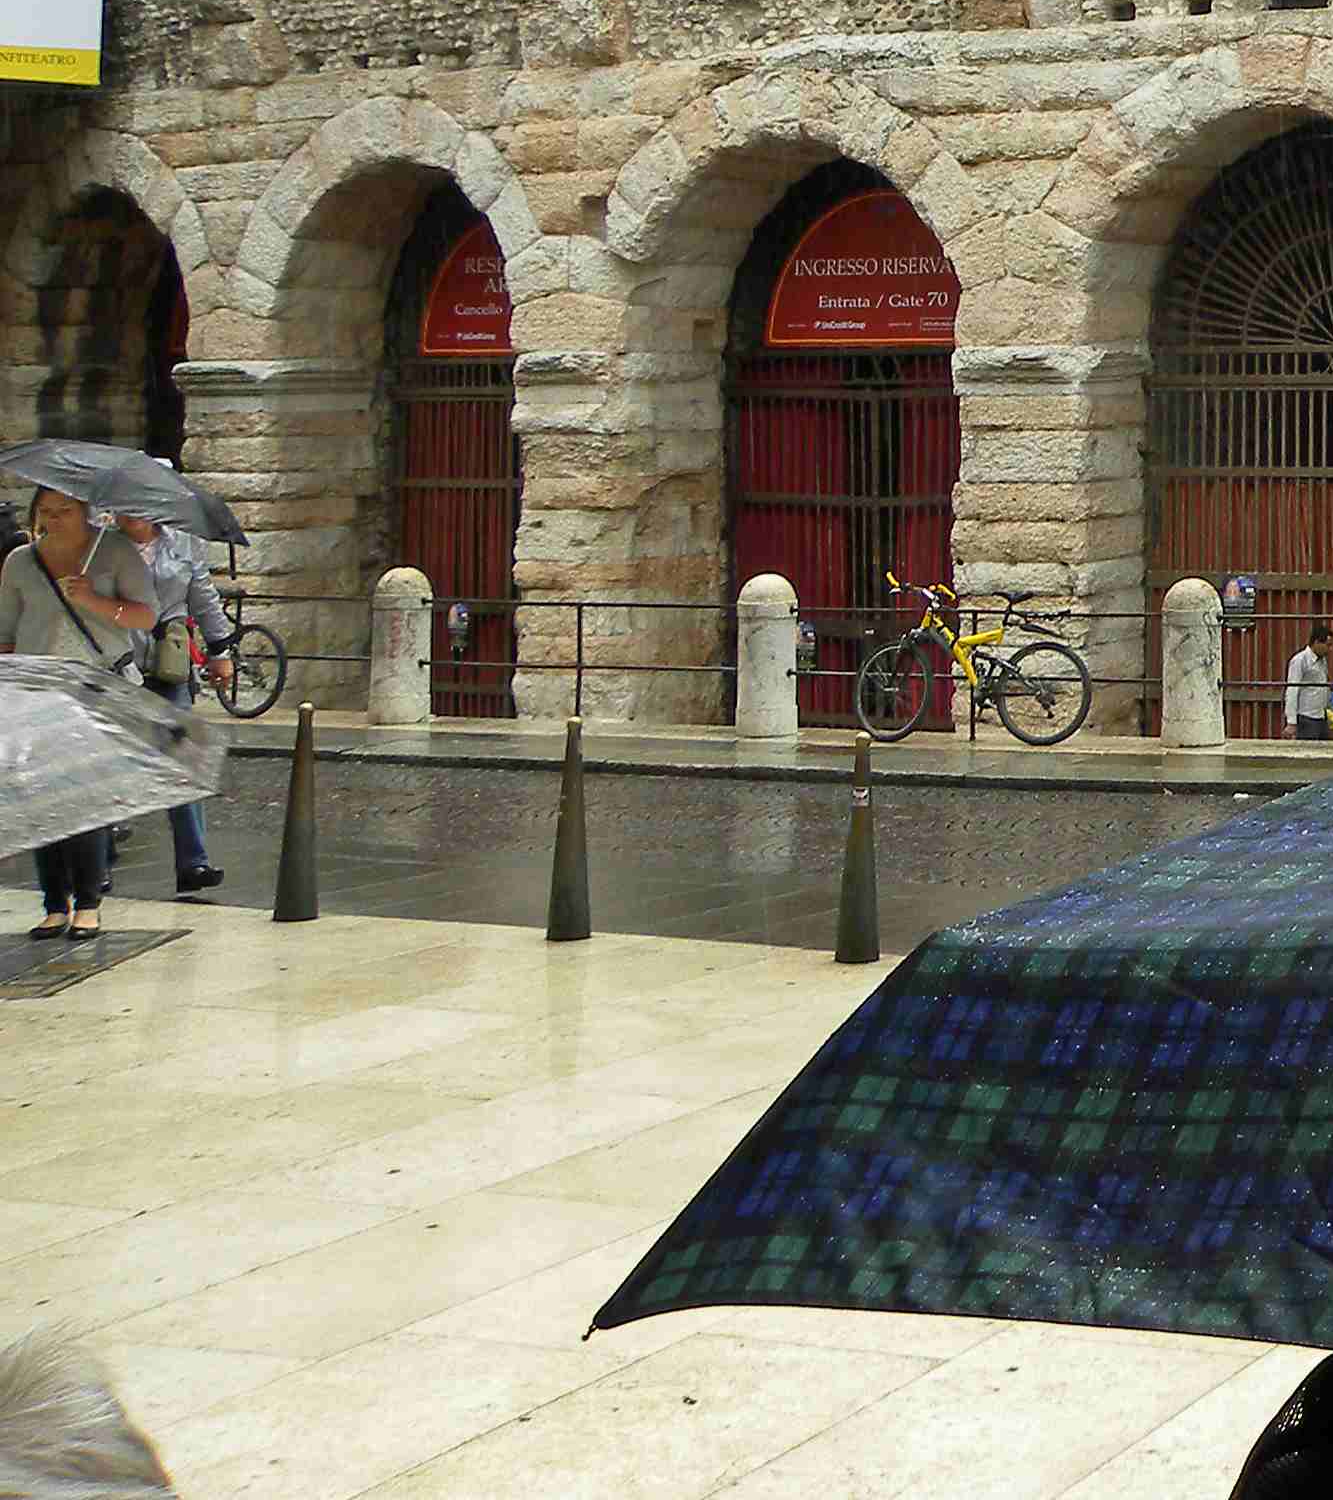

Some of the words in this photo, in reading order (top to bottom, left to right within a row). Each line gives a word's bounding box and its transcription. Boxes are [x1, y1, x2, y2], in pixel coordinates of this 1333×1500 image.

[794, 258, 879, 277] INGRESSO
[818, 293, 871, 309] Entrata
[875, 293, 884, 309] /
[888, 293, 924, 308] Gate
[927, 291, 949, 308] 70
